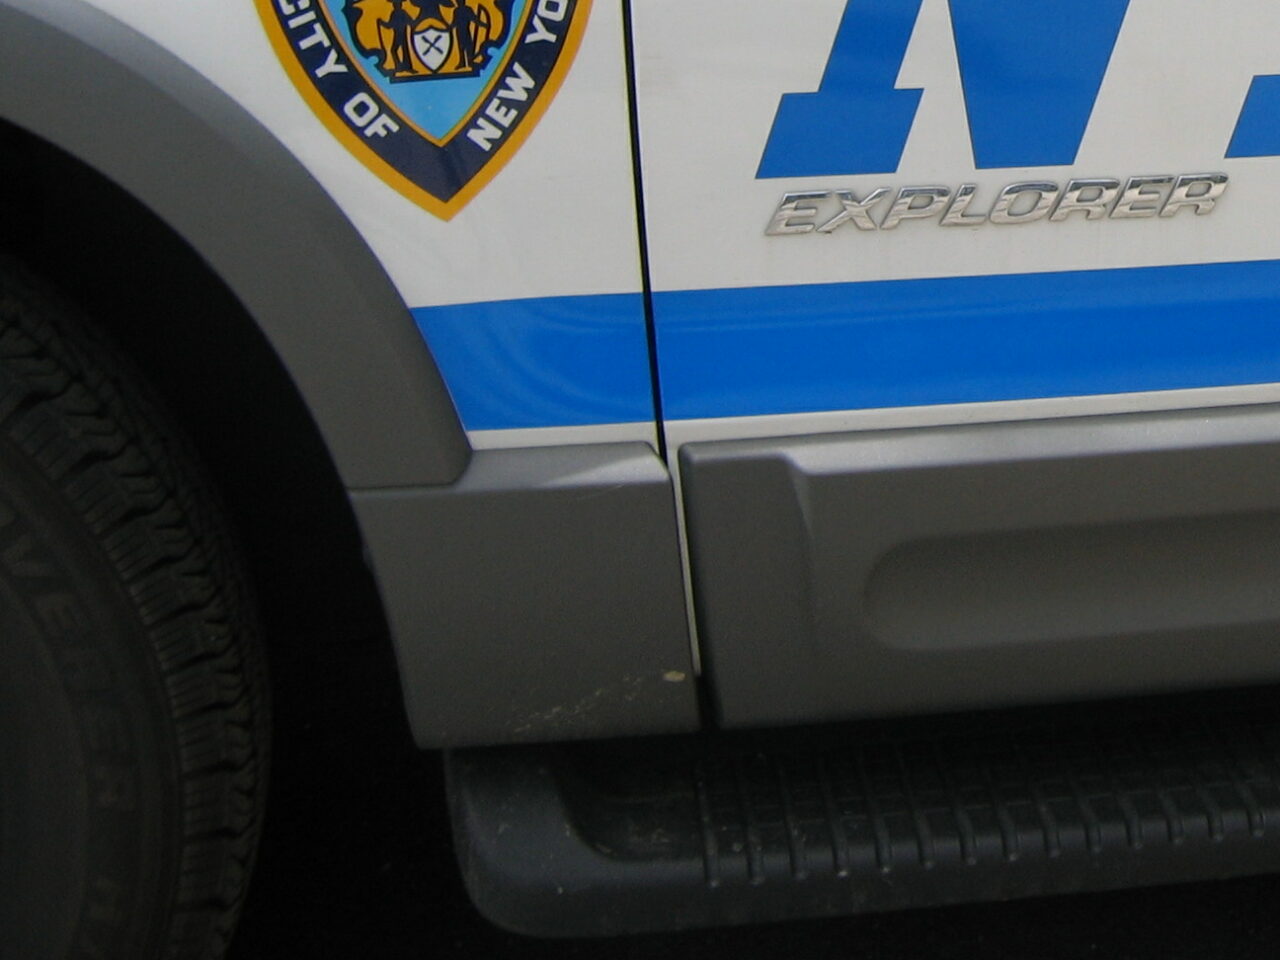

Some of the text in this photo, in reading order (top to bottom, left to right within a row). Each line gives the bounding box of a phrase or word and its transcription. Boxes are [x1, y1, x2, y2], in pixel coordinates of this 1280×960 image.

[343, 92, 399, 138] OF
[466, 63, 536, 152] NEW
[763, 172, 1229, 236] EXPLORER
